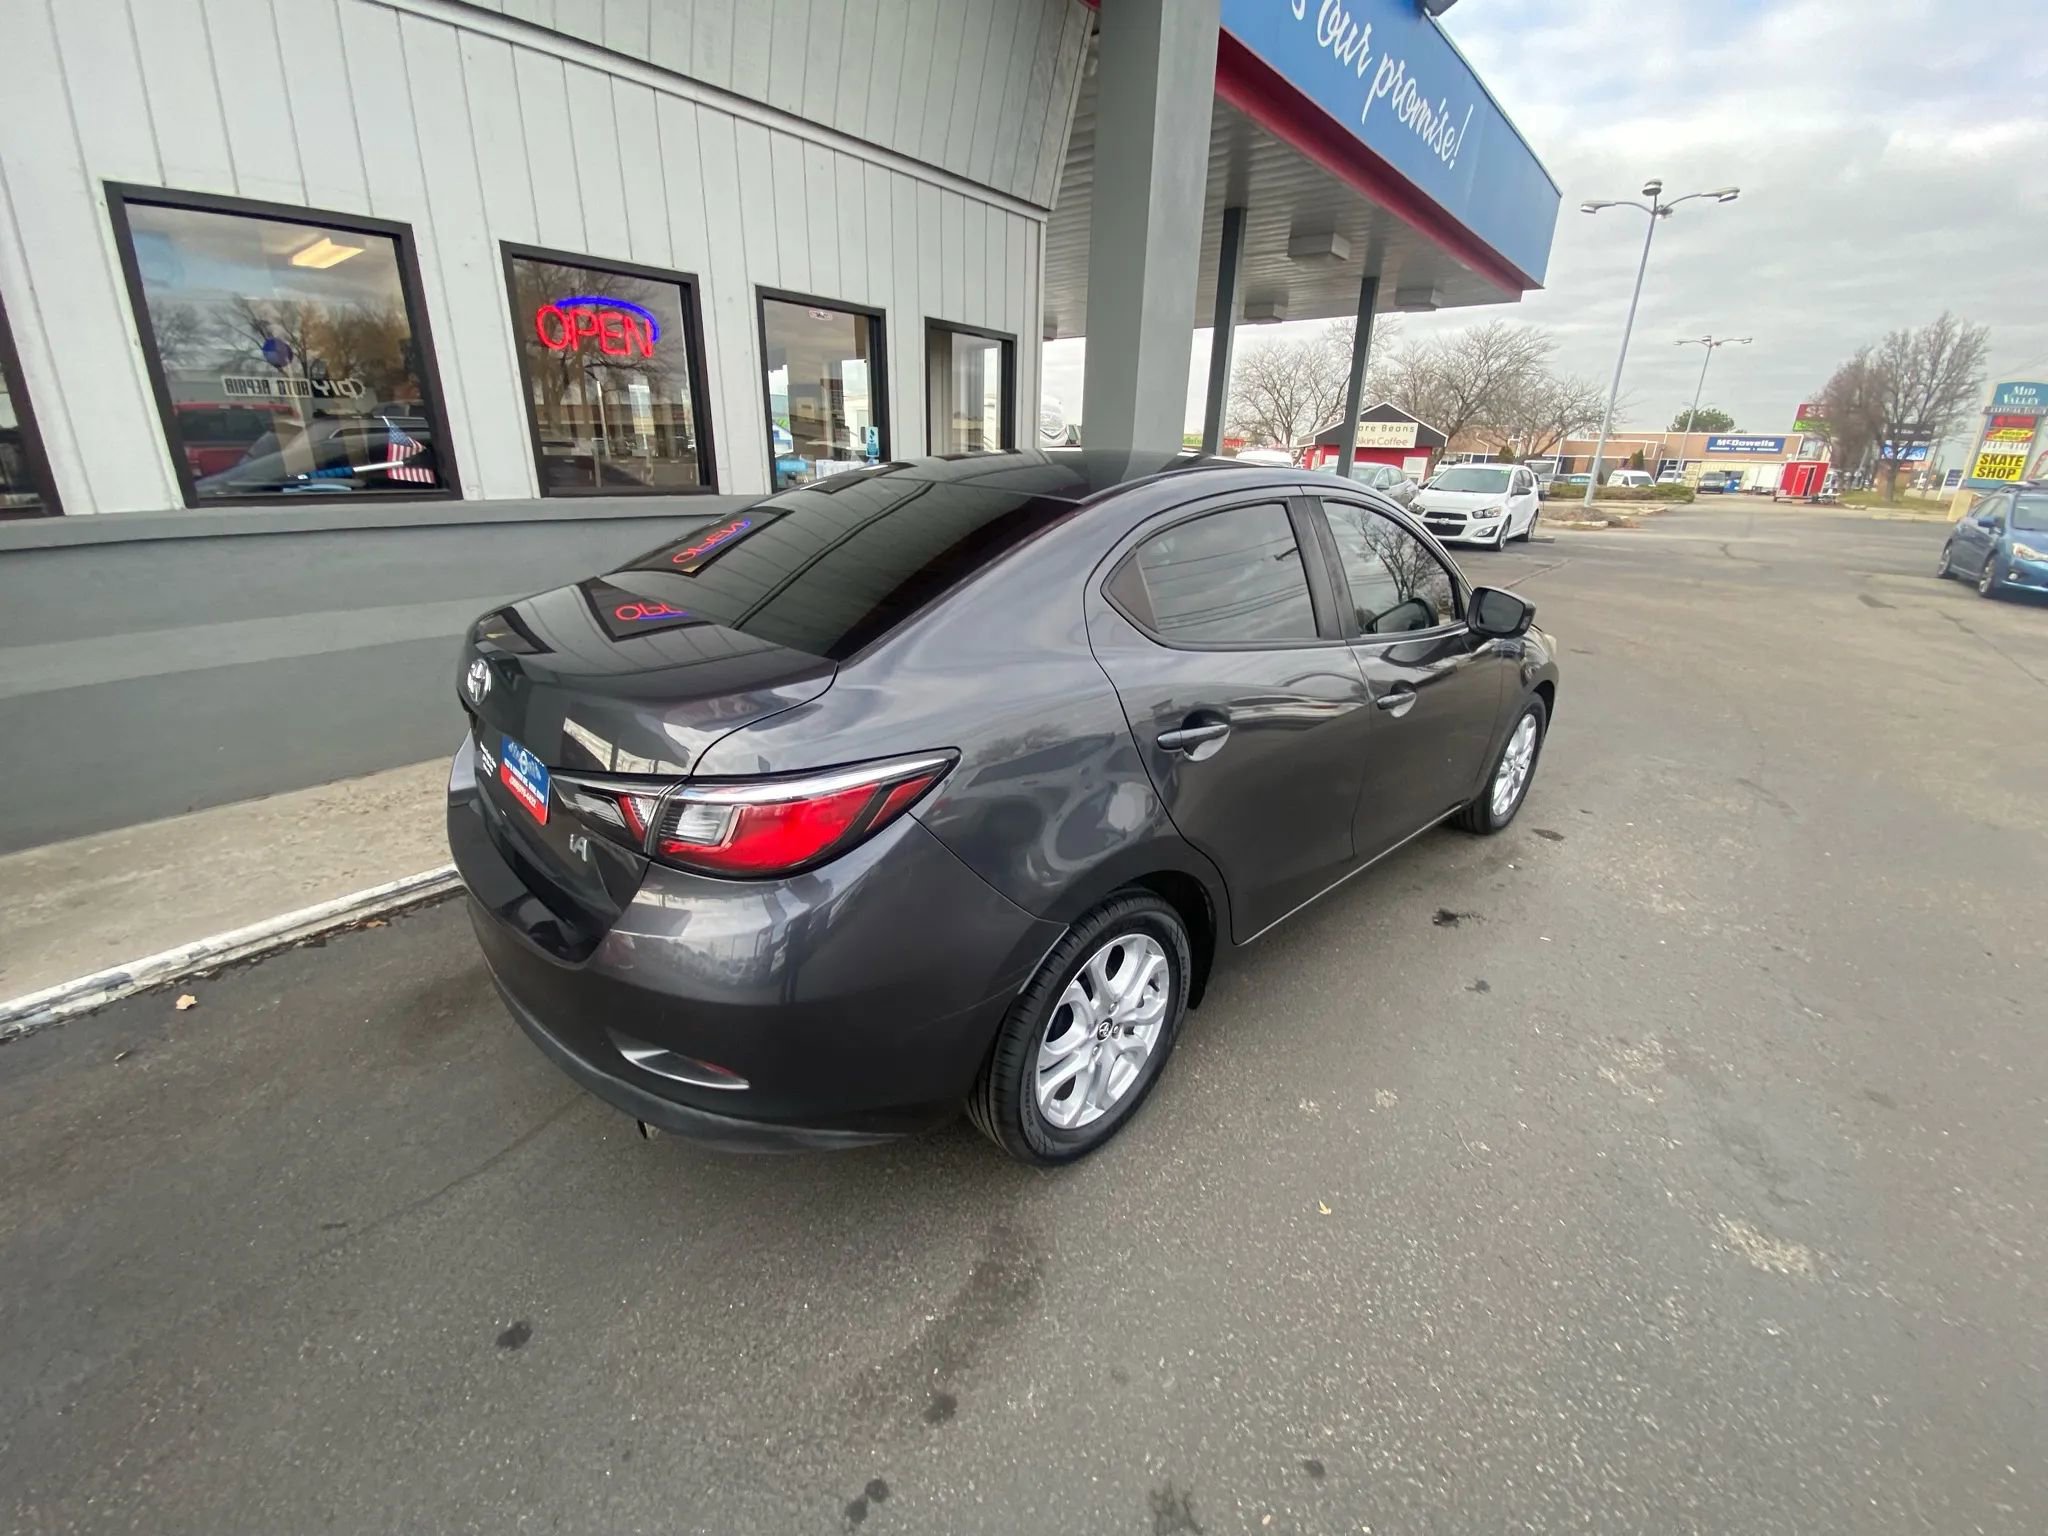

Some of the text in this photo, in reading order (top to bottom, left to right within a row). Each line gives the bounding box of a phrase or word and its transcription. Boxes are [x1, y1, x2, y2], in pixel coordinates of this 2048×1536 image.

[1317, 0, 1473, 170] our promise!
[535, 304, 655, 358] OPEN
[1977, 466, 2016, 480] SHOP
[1980, 452, 2024, 467] SKATE
